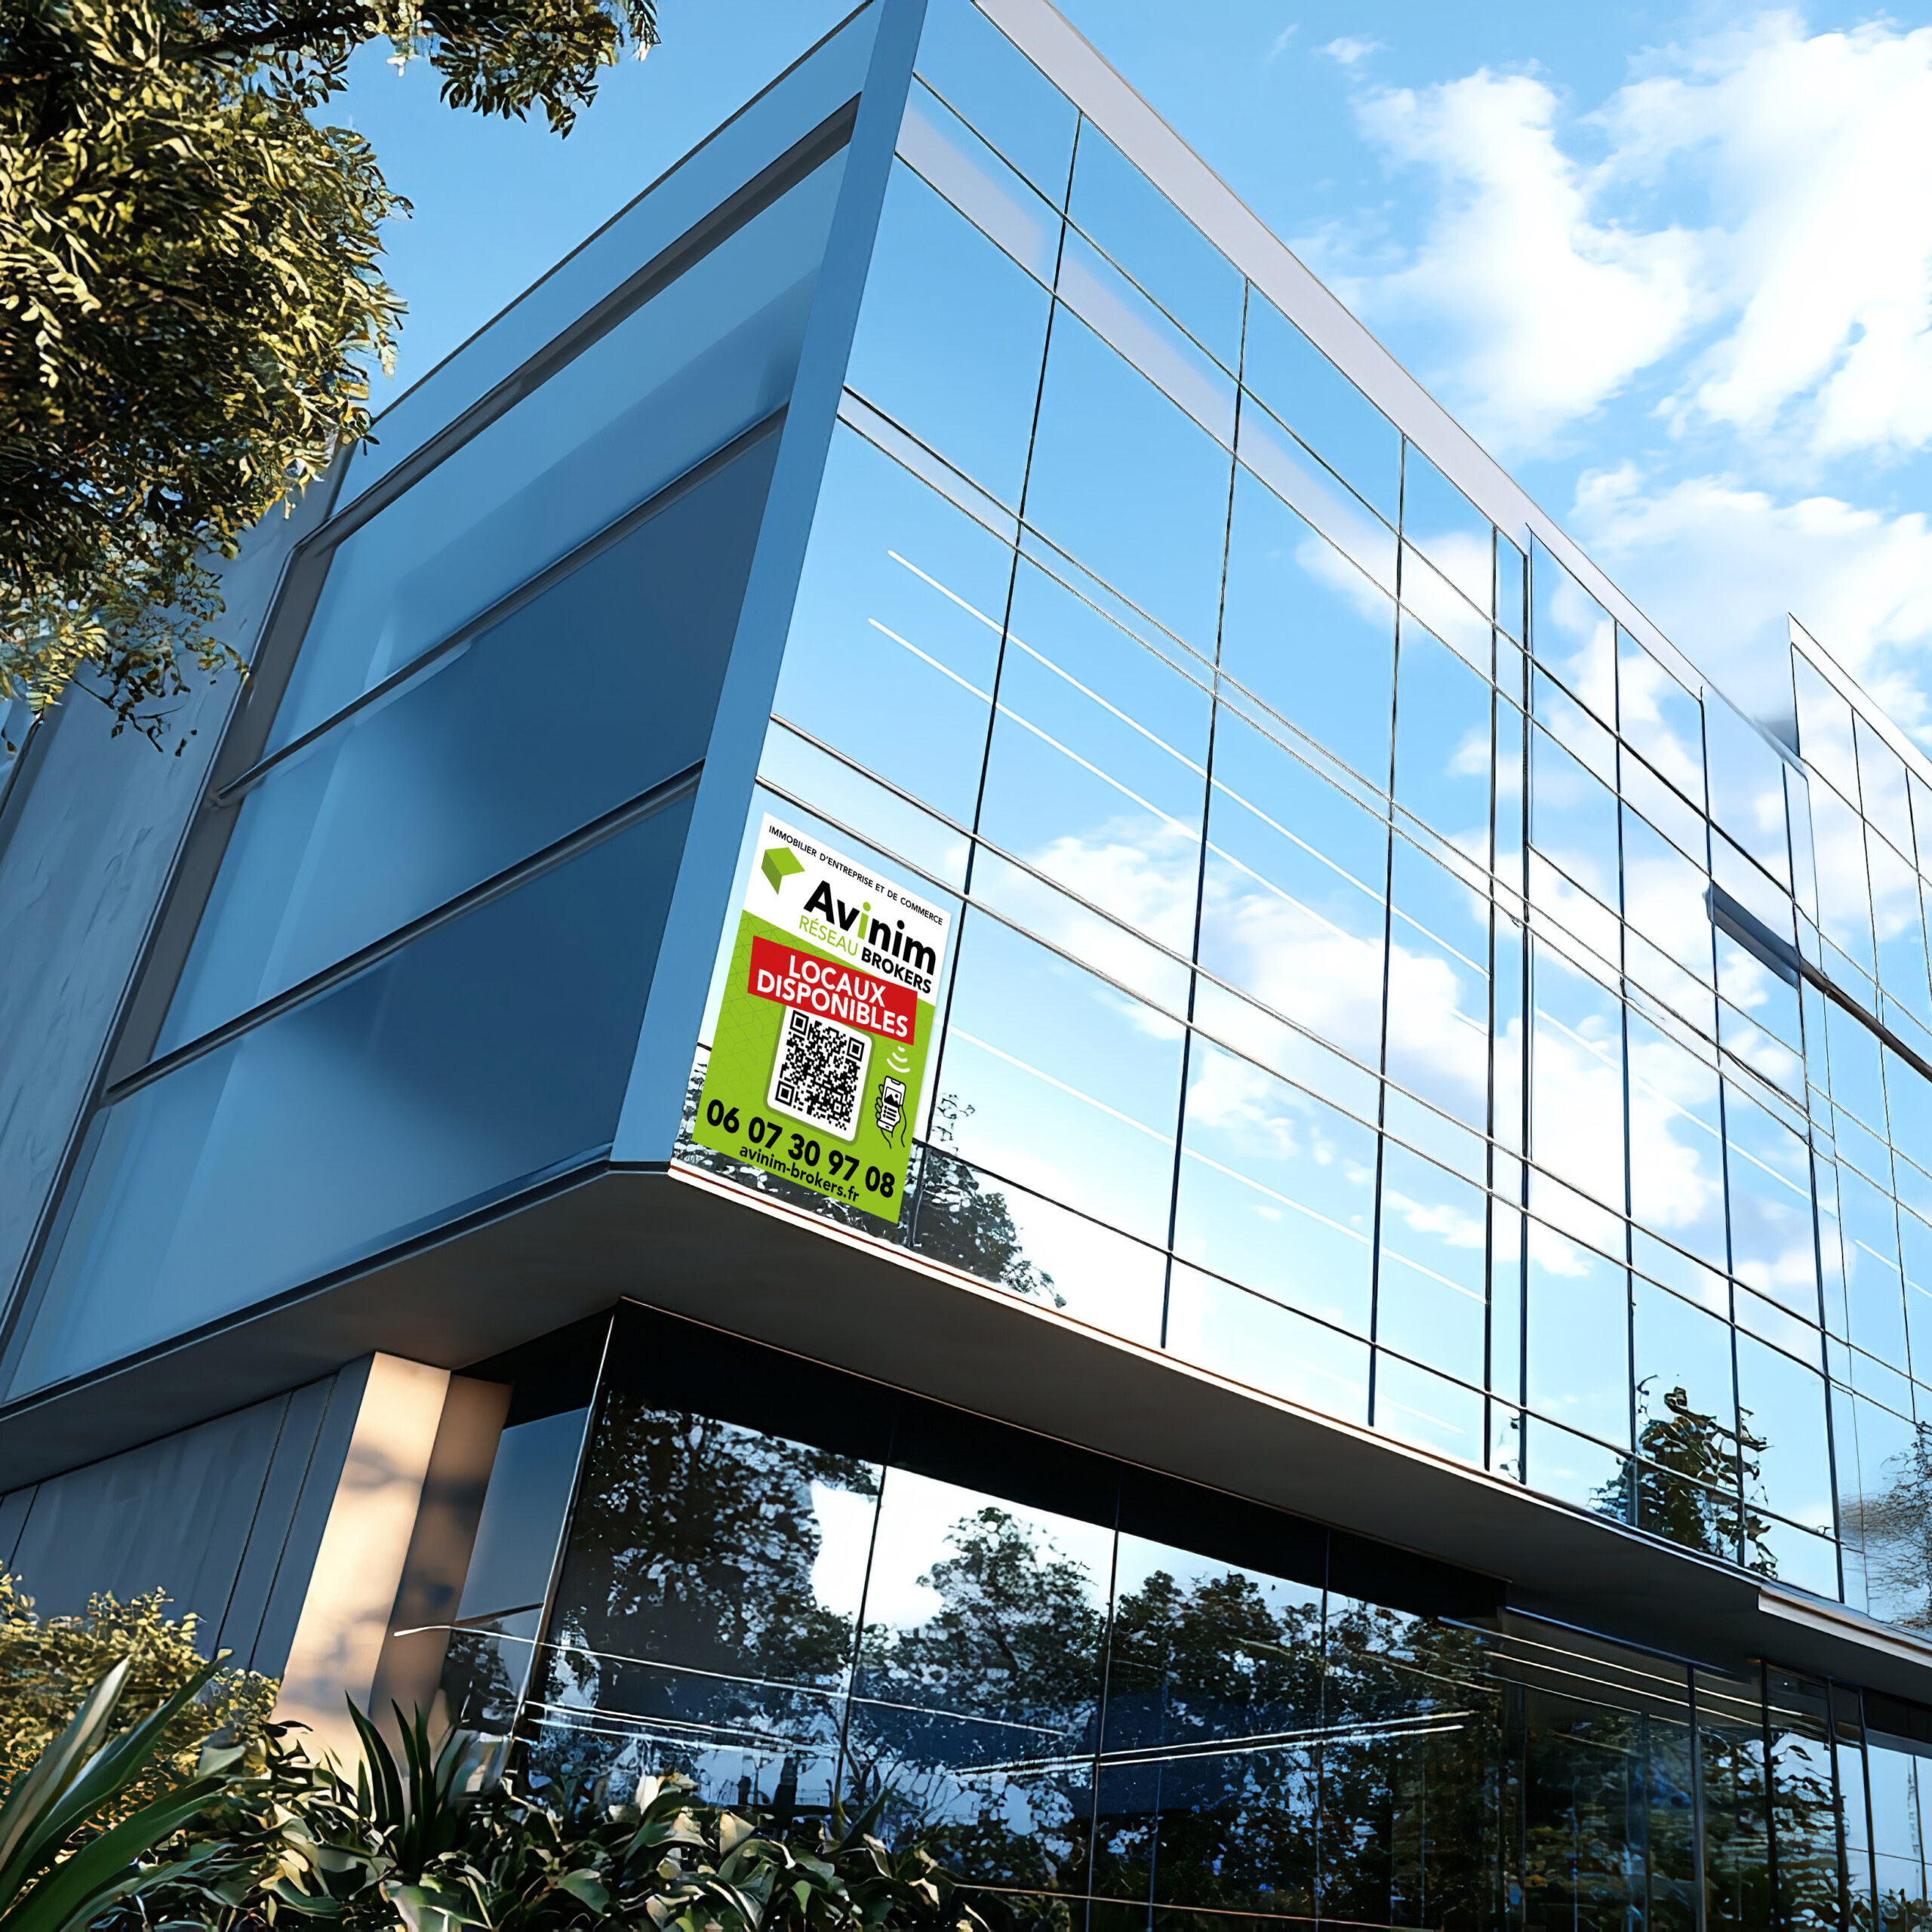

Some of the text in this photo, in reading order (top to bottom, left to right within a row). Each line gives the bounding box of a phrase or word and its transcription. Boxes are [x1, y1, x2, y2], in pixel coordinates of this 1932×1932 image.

[768, 825, 943, 925] IMMOBILIER D'ENTREPRISE ET DE COMMERCE
[799, 914, 932, 994] RÉSEAU BROKERS
[803, 880, 937, 976] Avinim
[757, 968, 909, 1037] DISPONIBLES
[789, 955, 887, 1007] LOCAUX
[706, 1099, 895, 1198] 06 07 30 97 08
[740, 1145, 860, 1202] avinim-brokers.fr
